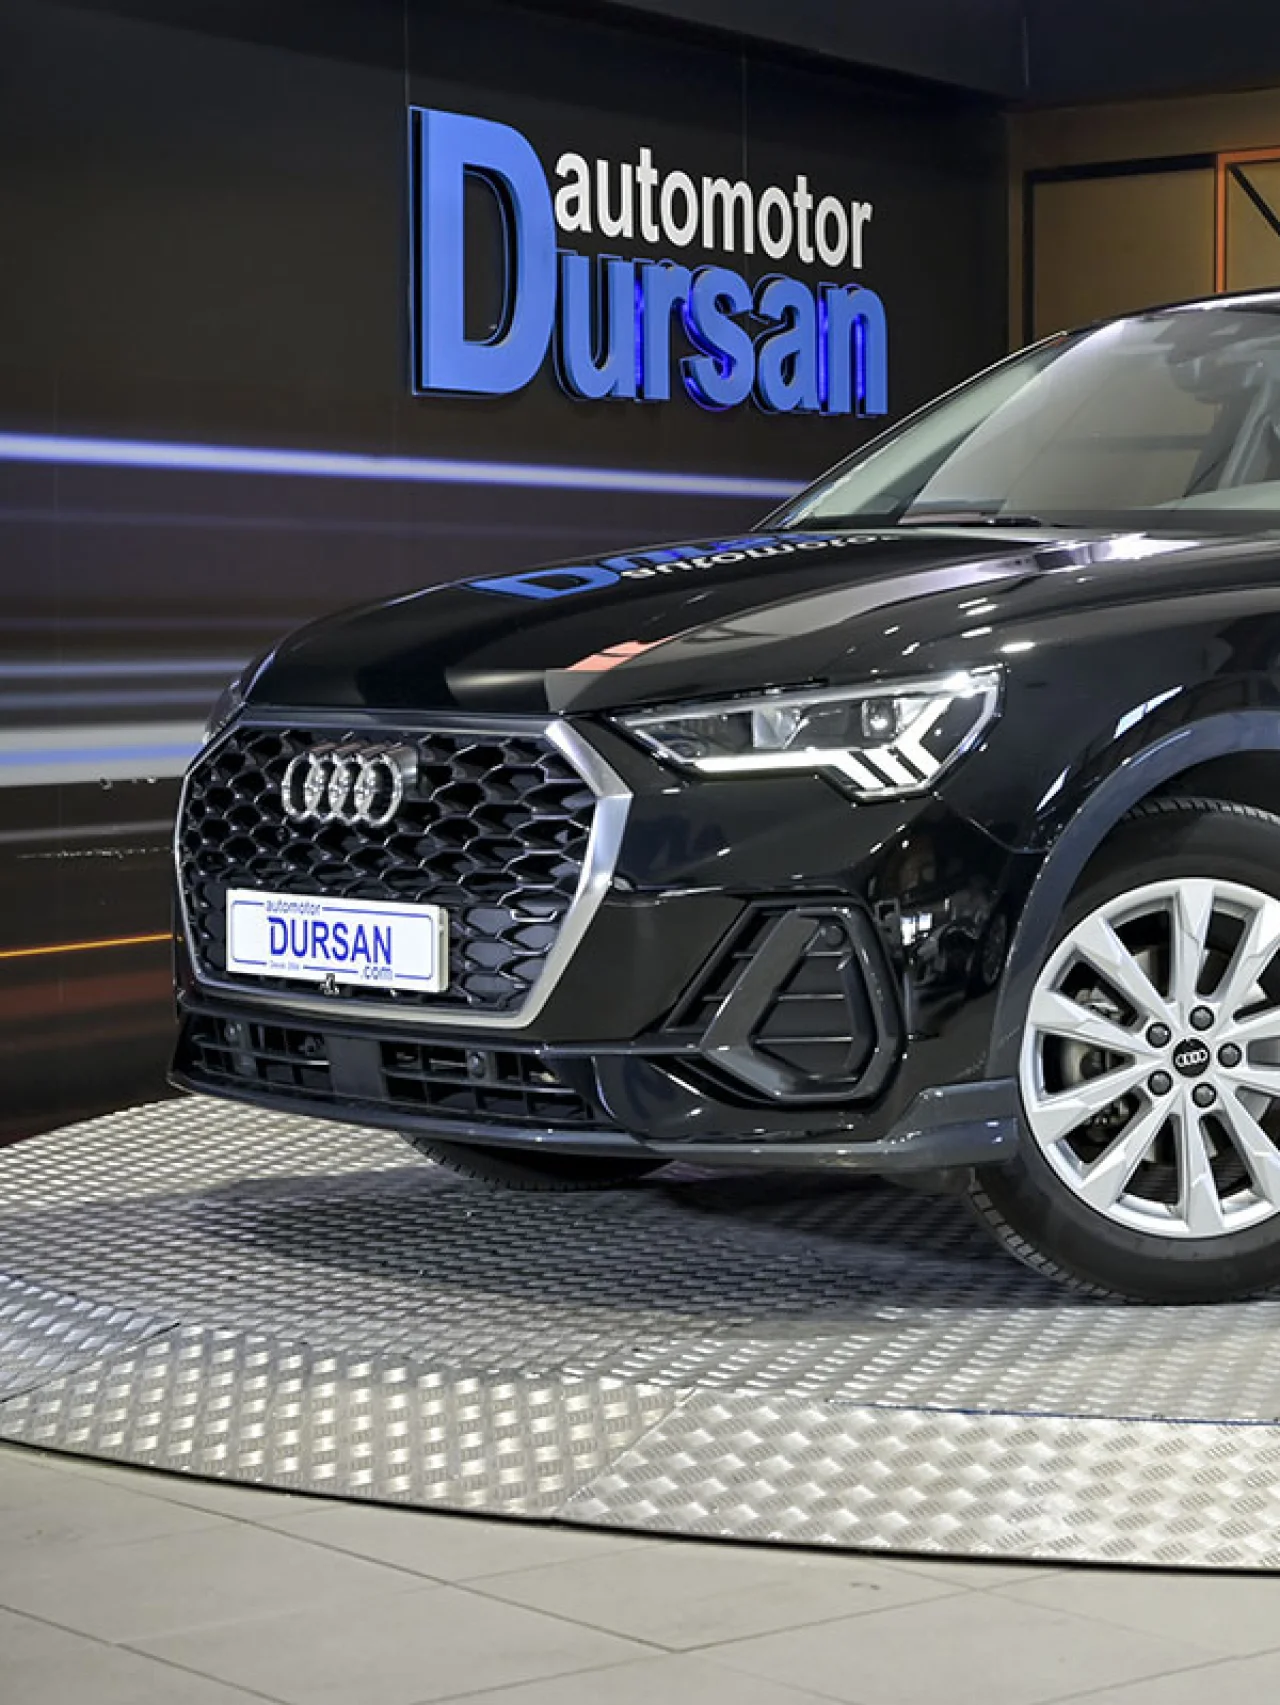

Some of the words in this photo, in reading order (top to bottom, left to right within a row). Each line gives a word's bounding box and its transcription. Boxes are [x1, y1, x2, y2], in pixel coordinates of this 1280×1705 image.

[555, 146, 873, 269] automotor
[409, 105, 889, 418] Dursan
[266, 899, 321, 916] automotor
[266, 916, 392, 965] DURSAN
